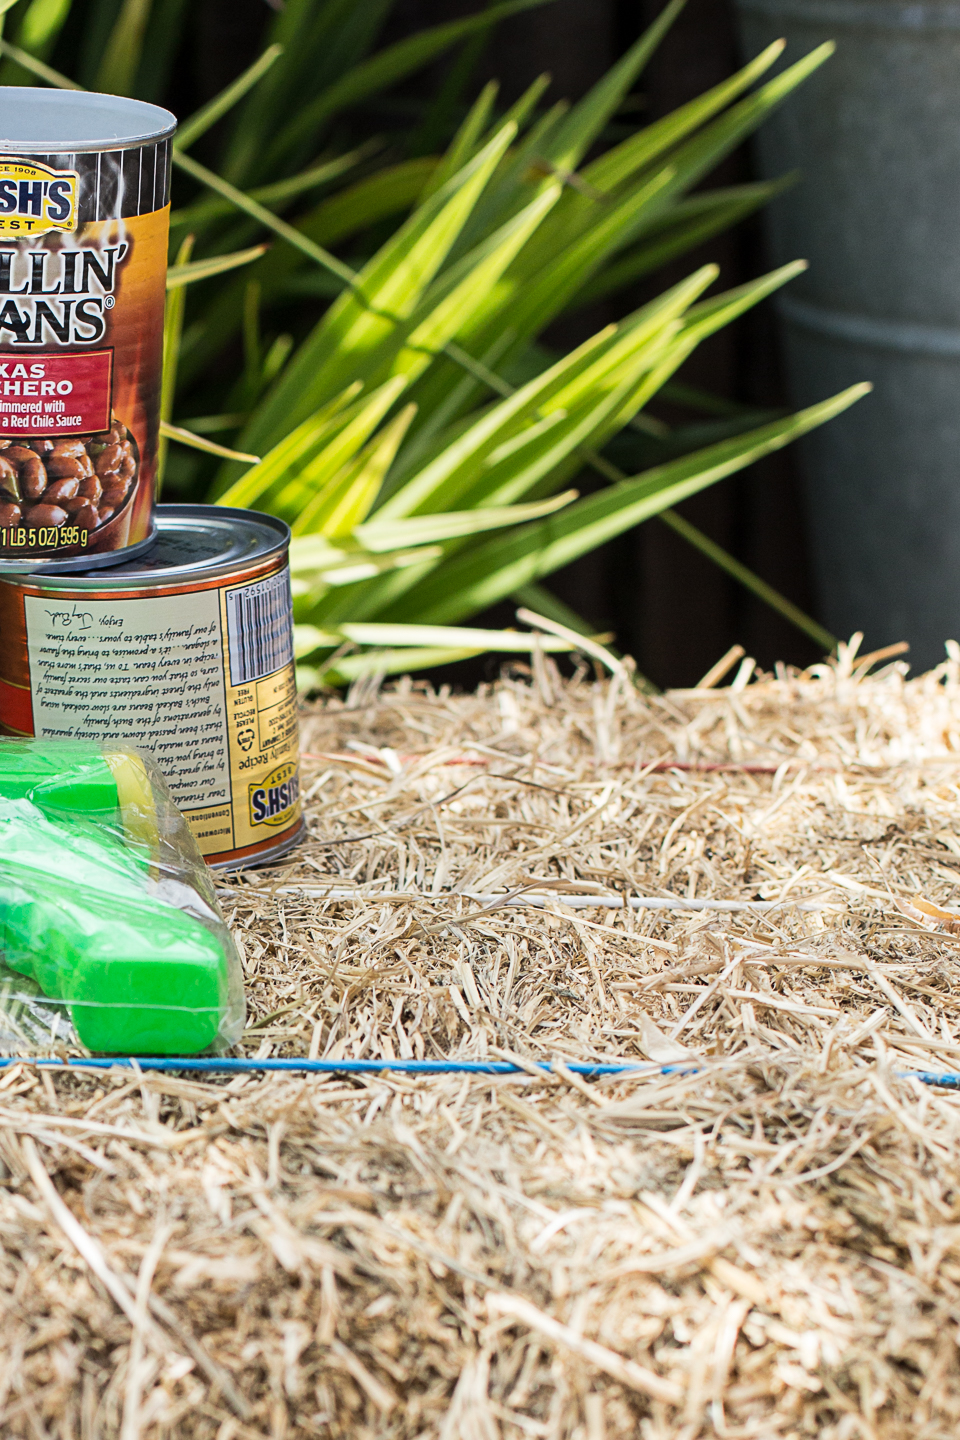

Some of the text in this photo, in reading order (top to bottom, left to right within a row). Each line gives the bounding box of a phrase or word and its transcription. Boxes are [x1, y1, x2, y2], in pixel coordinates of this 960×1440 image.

[14, 167, 37, 176] 1908
[44, 400, 65, 413] with
[1, 417, 9, 427] a
[11, 414, 29, 428] Red
[30, 414, 54, 428] Chile
[55, 415, 82, 427] Sauce
[10, 527, 27, 547] LB
[27, 528, 37, 547] 5
[37, 527, 59, 548] OZ)
[60, 526, 79, 545] 595
[80, 529, 89, 548] g
[98, 614, 124, 629] Enjoy,
[45, 620, 217, 644] of our family's table to time.
[39, 645, 60, 657] flavor
[61, 649, 75, 659] the
[76, 645, 99, 659] bring
[101, 650, 110, 658] to
[112, 645, 149, 657] promise,
[37, 659, 55, 668] than
[56, 661, 76, 670] more
[78, 663, 102, 672] that's
[103, 662, 116, 670] us,
[118, 663, 129, 671] To
[133, 662, 156, 671] bean.
[158, 656, 180, 669] every
[182, 657, 192, 668] in
[43, 666, 219, 687] care, so that you can taste our secret family
[35, 680, 220, 701] only the finest ingredients and the greatest of
[238, 688, 249, 697] FREE
[40, 696, 210, 715] Bush's Baked Beans are slow cooked, using
[234, 695, 253, 706] GLUTEN
[82, 705, 222, 729] by generations of the Bush family.
[234, 708, 255, 721] RECYCLE
[236, 717, 254, 728] PLEASE
[41, 721, 222, 741] that's been passed down and closely guarded
[158, 735, 223, 752] beans are made
[157, 748, 224, 765] to bring you this
[239, 753, 268, 770] Recipe
[202, 762, 225, 773] by my
[172, 789, 226, 804] Dear Friends,
[186, 809, 230, 823] Conventional:
[195, 827, 231, 839] Microwave:
